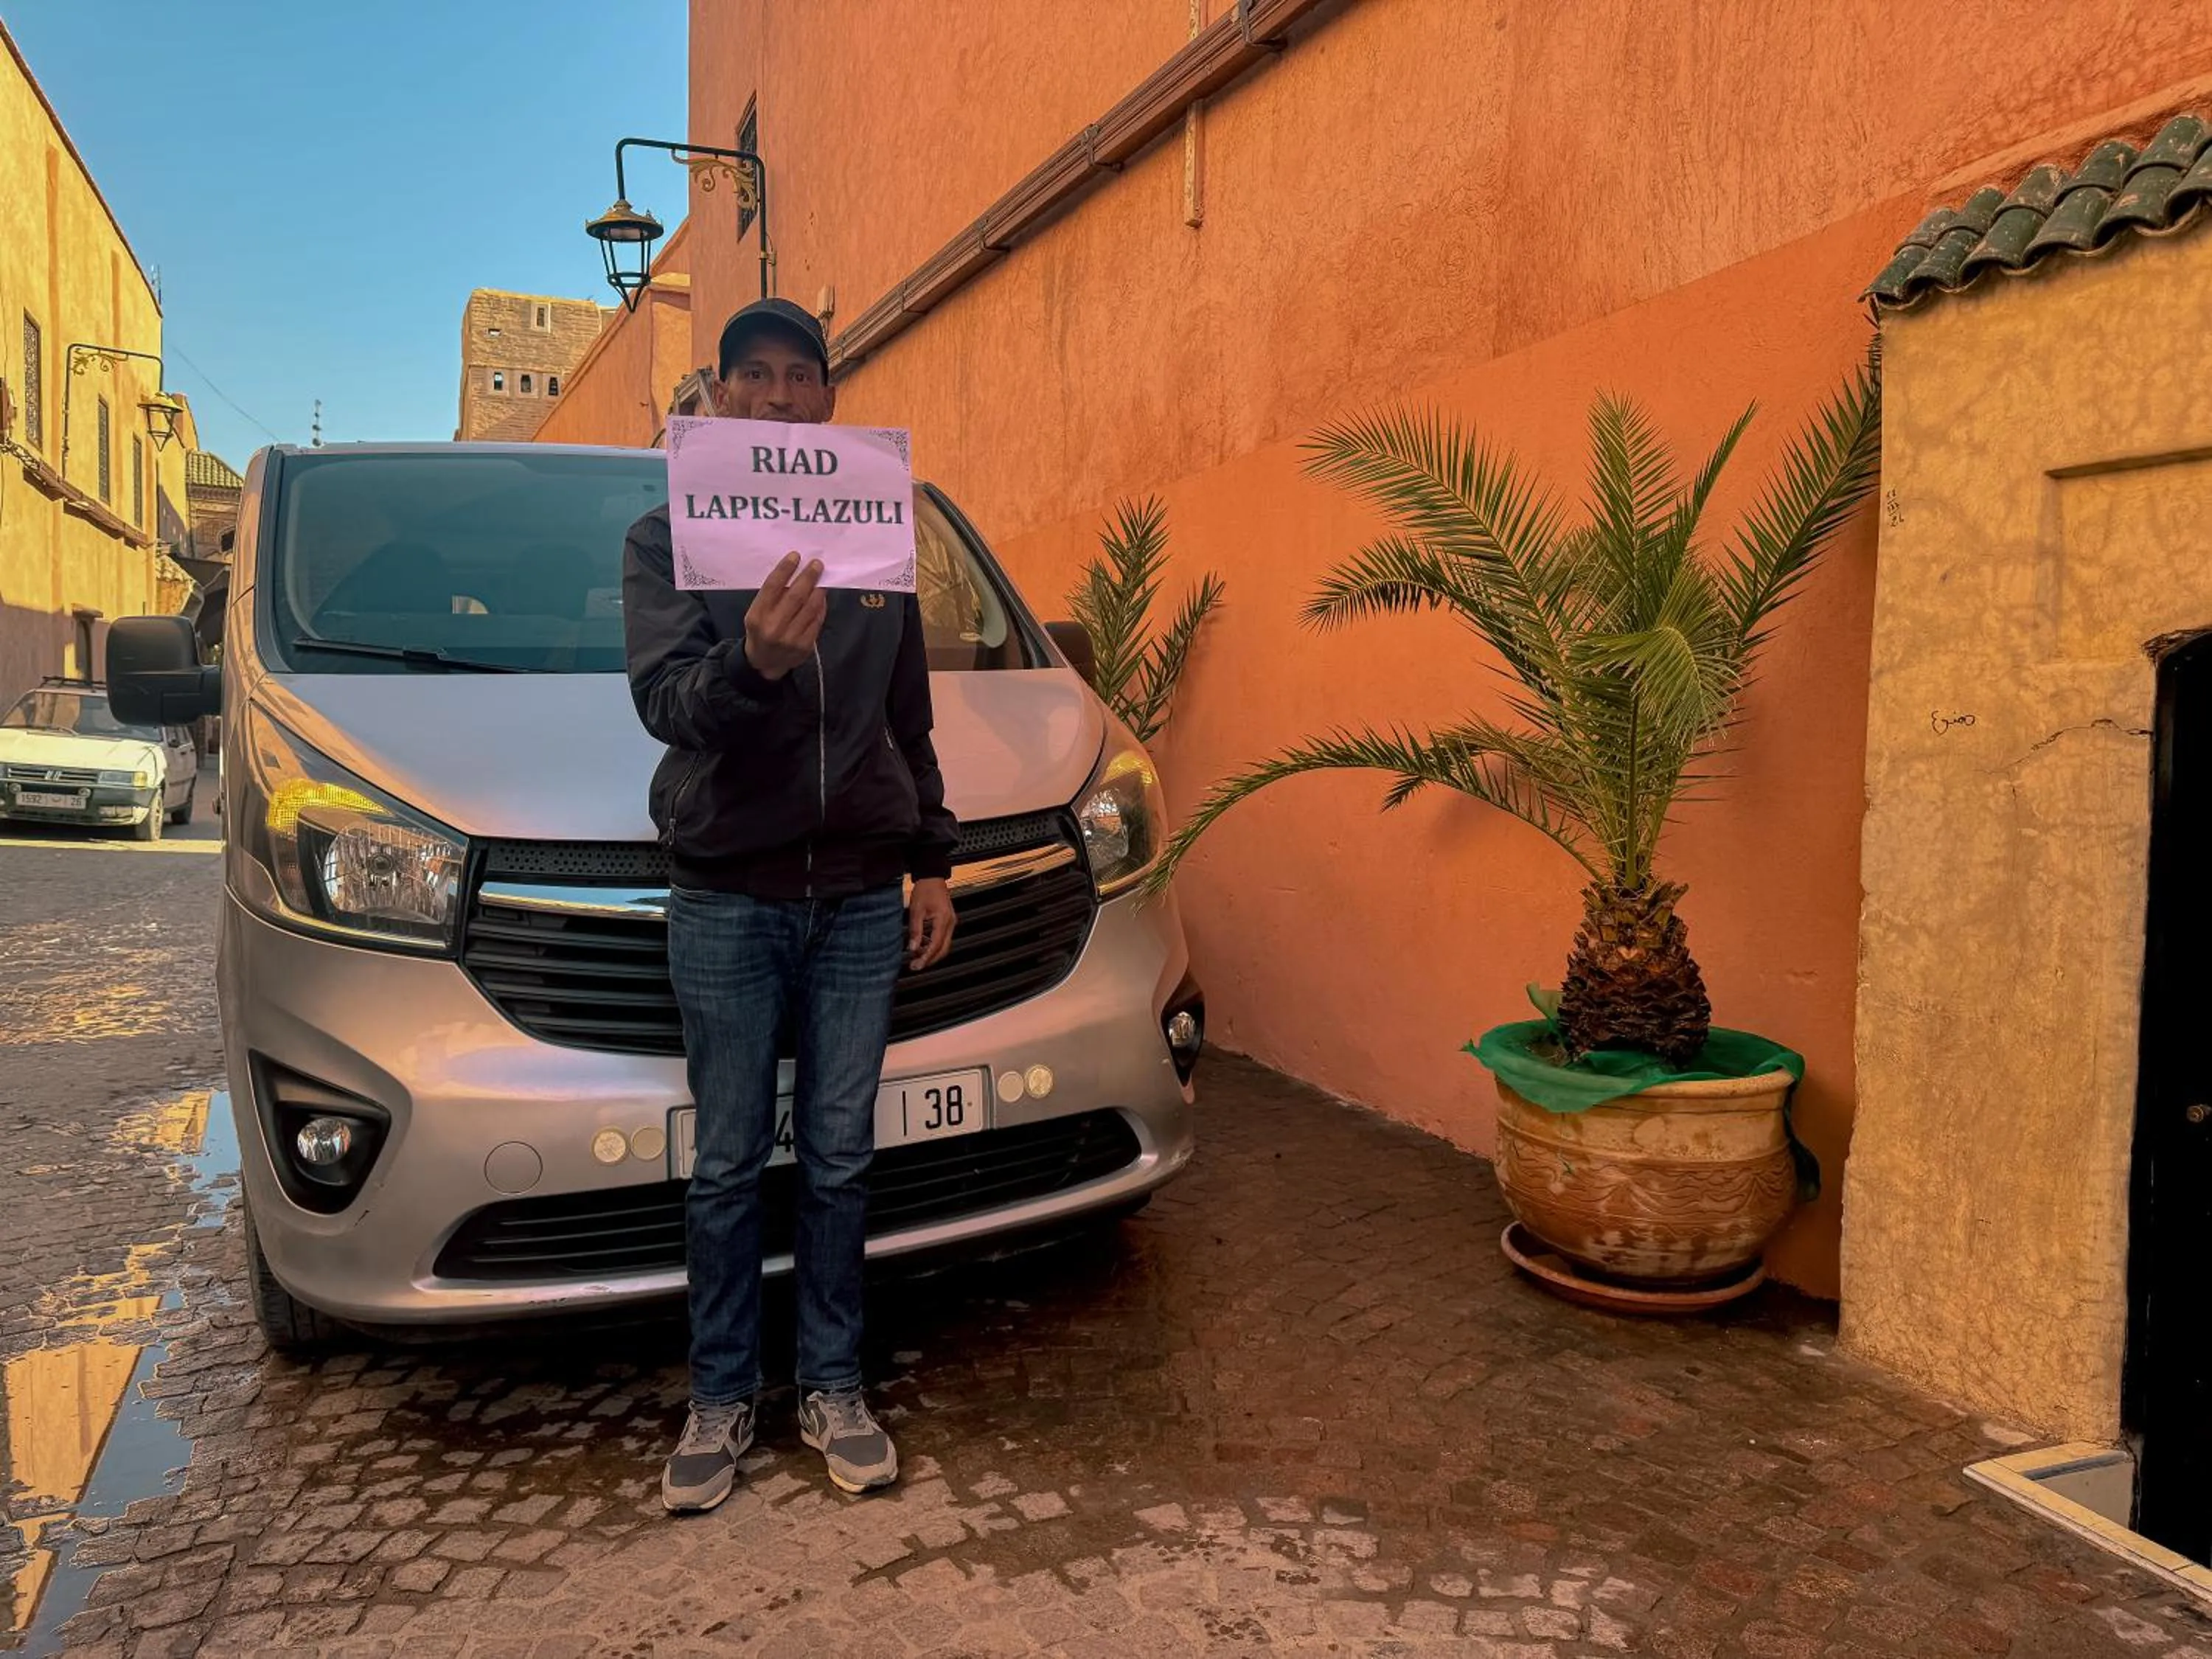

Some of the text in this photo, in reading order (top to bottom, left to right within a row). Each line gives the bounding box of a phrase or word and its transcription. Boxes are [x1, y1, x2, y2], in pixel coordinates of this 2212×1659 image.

[751, 446, 838, 476] RIAD
[686, 494, 905, 524] LAPIS-LAZULI
[925, 1085, 964, 1130] 38
